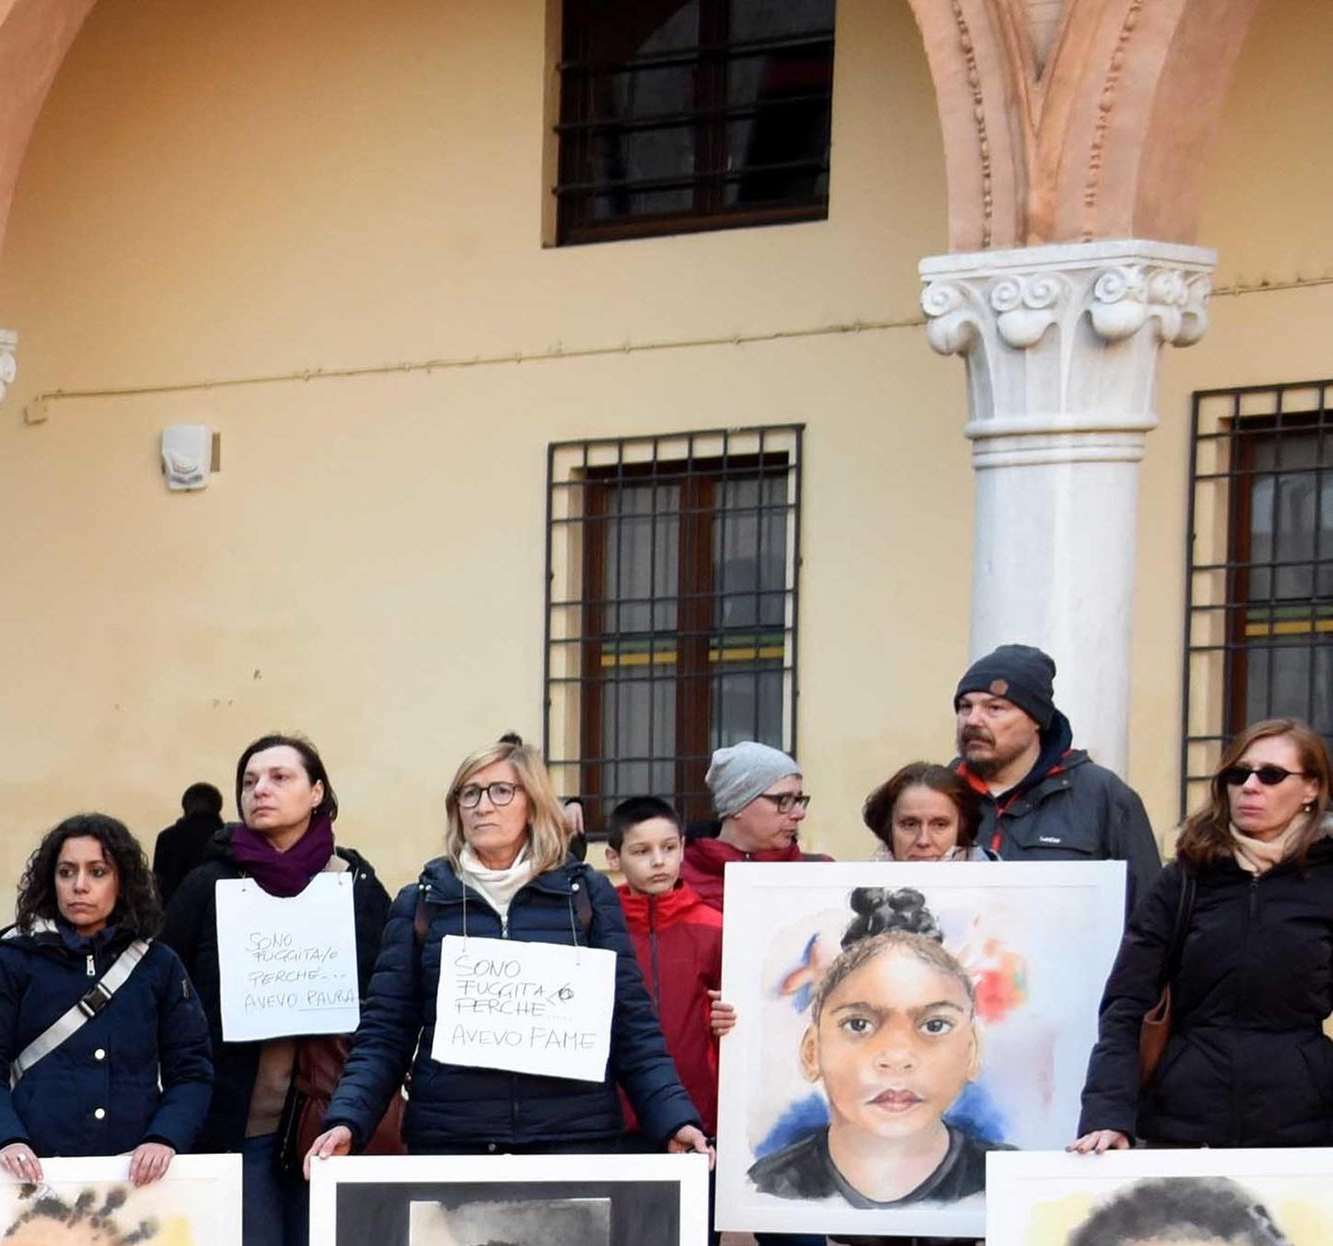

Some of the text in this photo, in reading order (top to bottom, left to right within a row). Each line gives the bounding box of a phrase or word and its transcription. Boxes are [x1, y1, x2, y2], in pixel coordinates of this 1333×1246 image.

[454, 955, 521, 977] SONO
[245, 993, 298, 1015] AVEVO
[451, 1024, 597, 1051] AVEVO FAME
